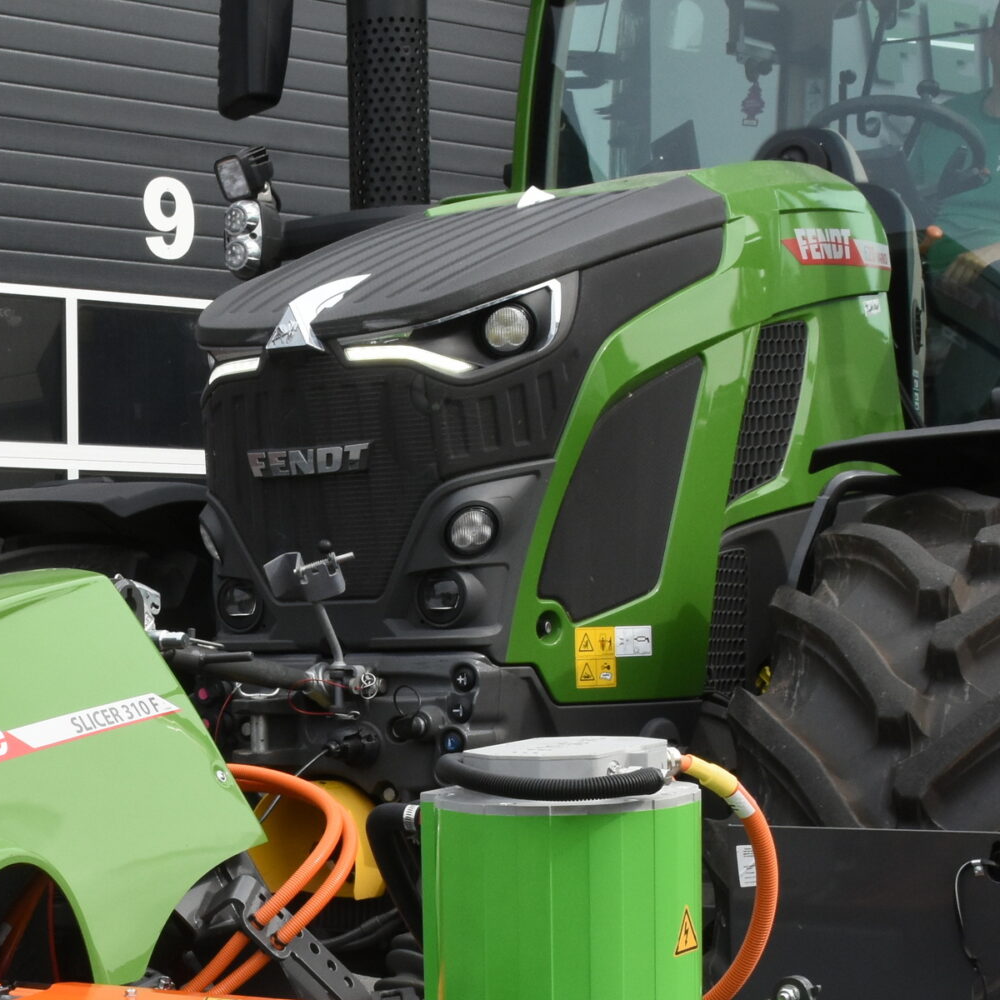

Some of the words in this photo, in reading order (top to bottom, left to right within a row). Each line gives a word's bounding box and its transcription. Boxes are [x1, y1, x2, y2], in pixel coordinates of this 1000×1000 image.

[142, 175, 196, 261] 9
[793, 228, 851, 261] FENDT
[246, 441, 371, 478] FENDT
[70, 706, 124, 734] SLICER
[121, 700, 151, 721] 310
[148, 696, 160, 713] F
